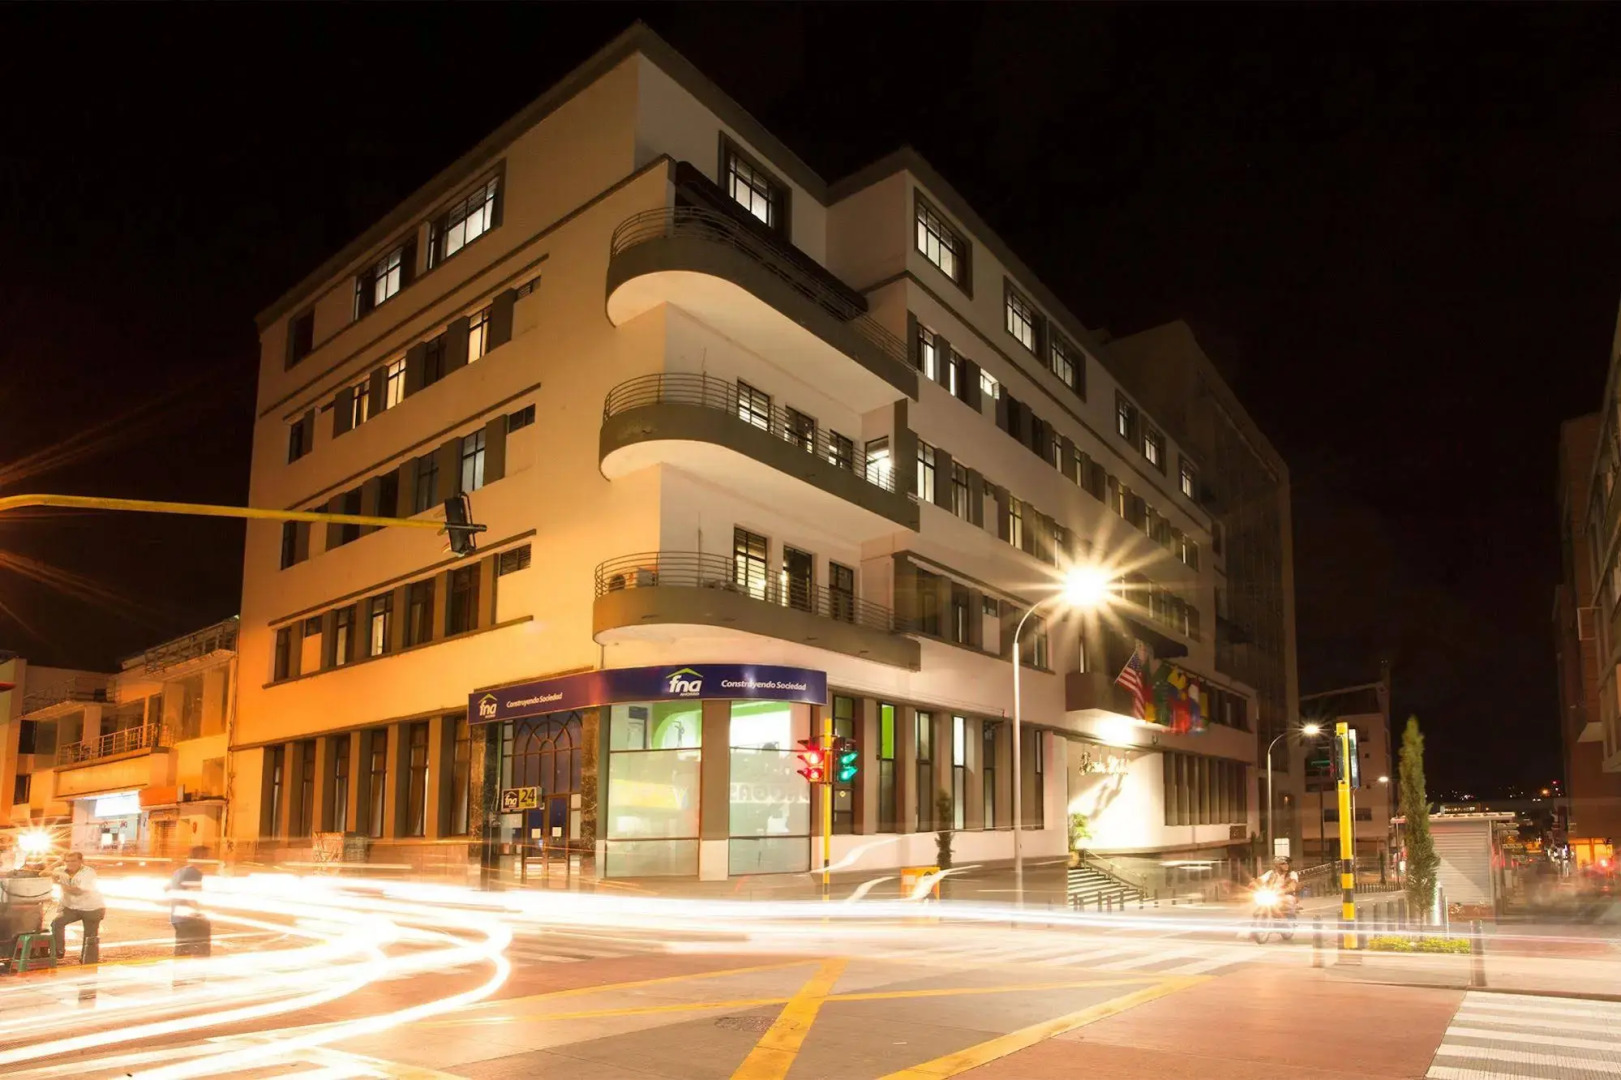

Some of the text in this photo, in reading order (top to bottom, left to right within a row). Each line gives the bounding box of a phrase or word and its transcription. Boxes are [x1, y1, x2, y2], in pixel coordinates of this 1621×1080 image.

[669, 675, 702, 693] fna
[721, 679, 806, 691] Construyendo Sociedad
[506, 692, 562, 708] Construyendo Sociedad
[479, 700, 497, 716] fna
[504, 794, 518, 806] fna
[520, 789, 535, 802] 24
